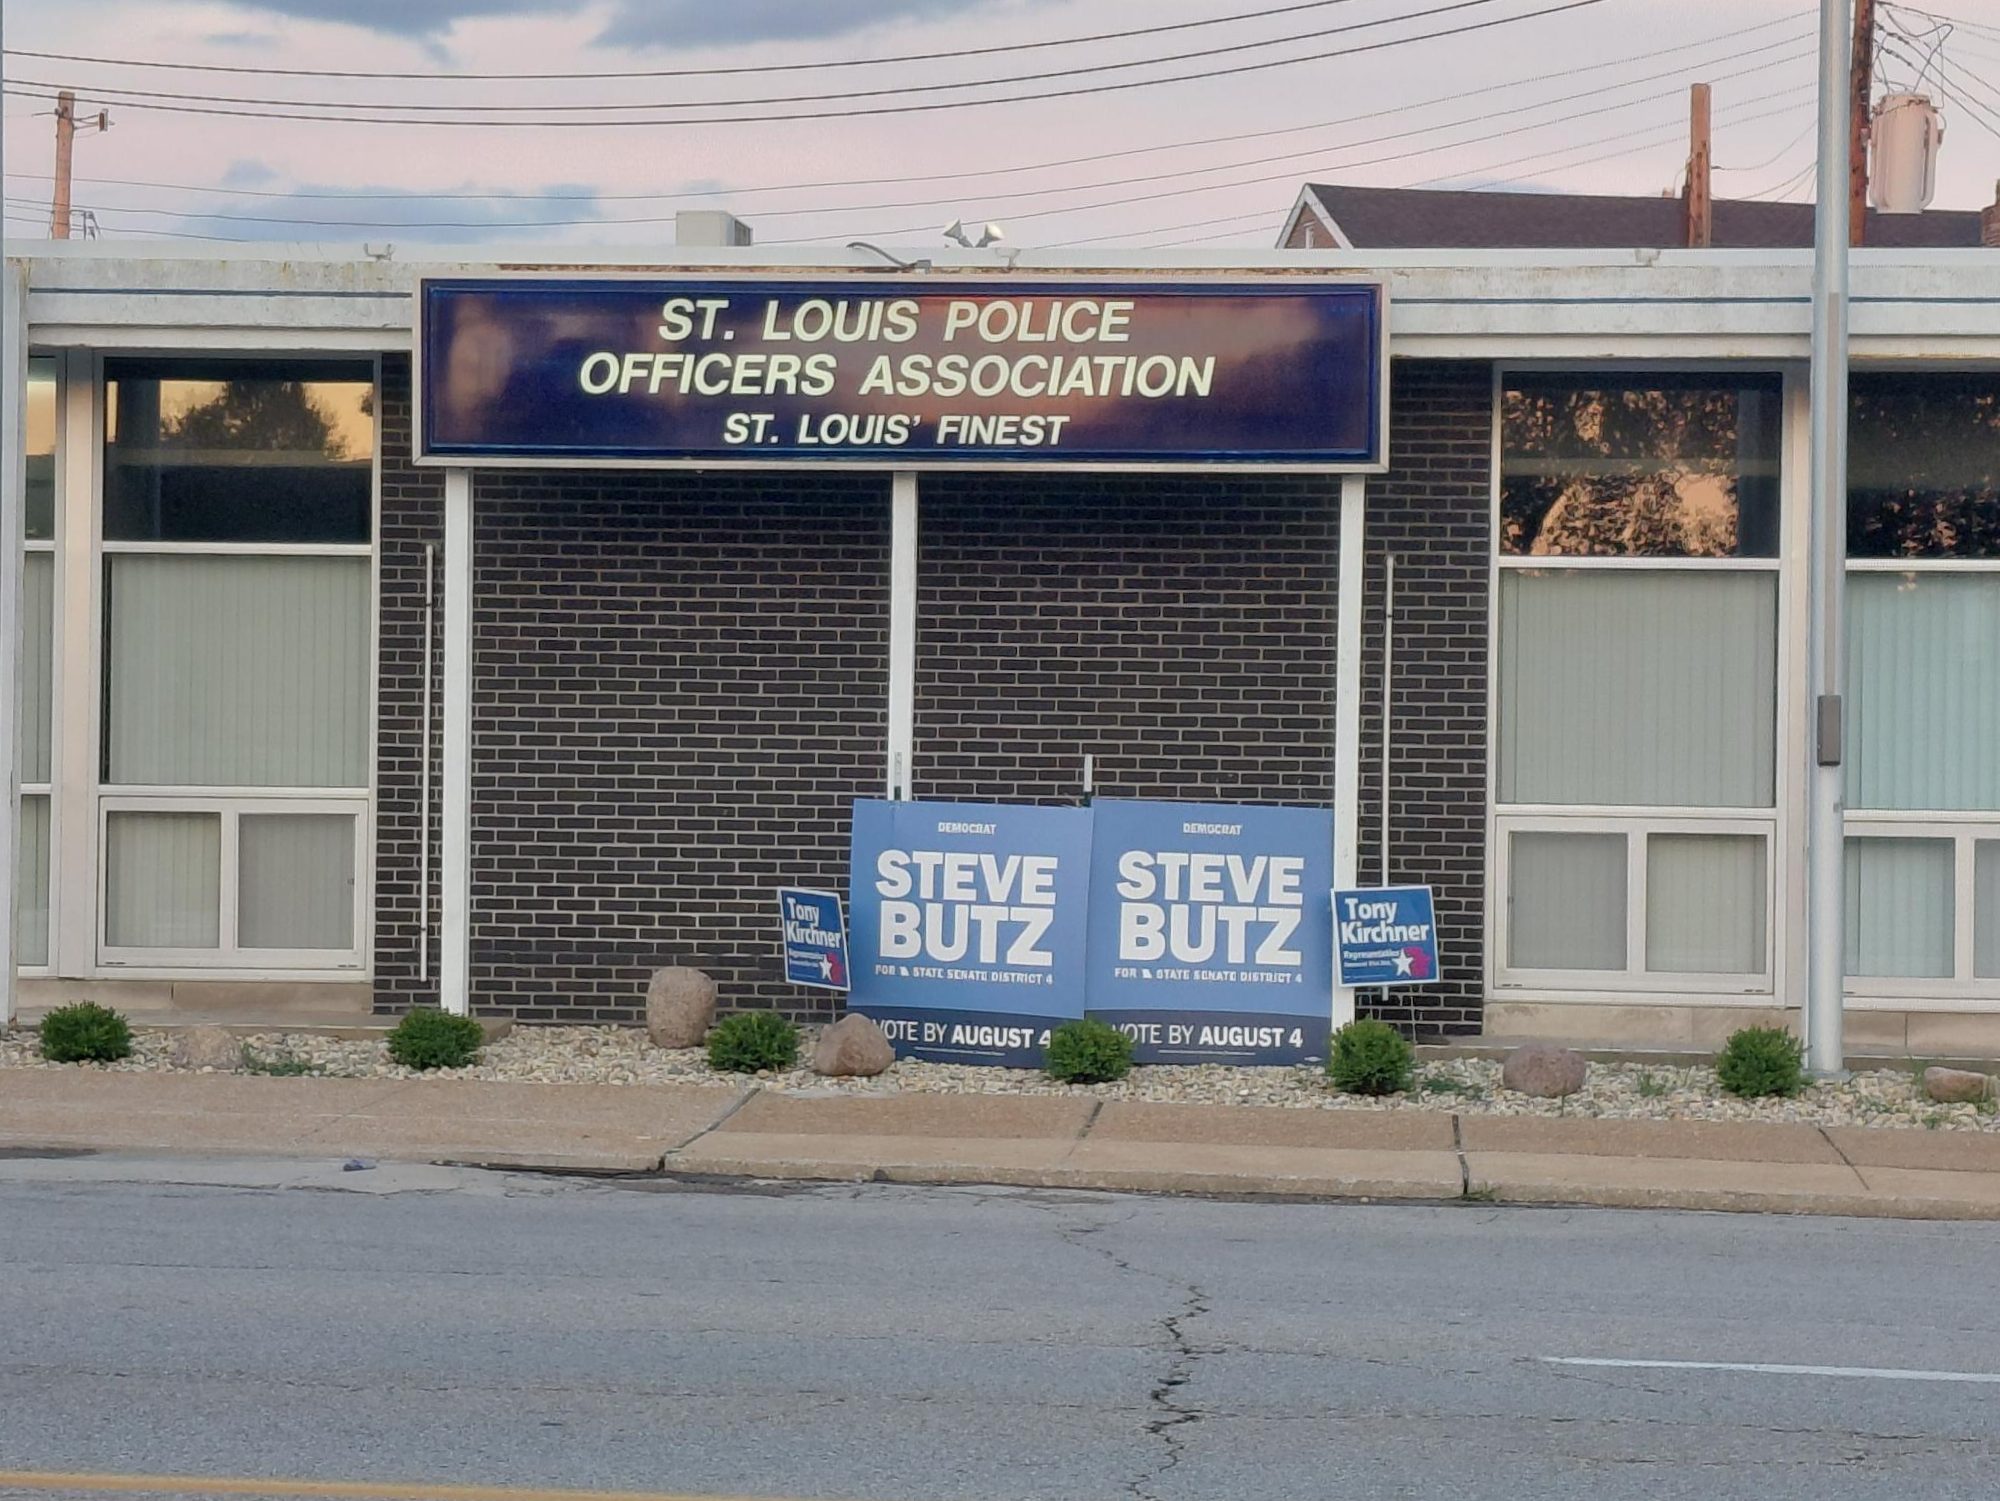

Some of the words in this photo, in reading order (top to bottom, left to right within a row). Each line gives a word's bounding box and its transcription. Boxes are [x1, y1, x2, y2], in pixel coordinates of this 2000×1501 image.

[658, 298, 735, 341] ST.
[762, 299, 919, 342] LOUIS
[943, 300, 1134, 342] POLICE
[580, 351, 837, 396] OFFICERS
[858, 354, 1215, 397] ASSOCIATION
[723, 413, 779, 444] ST.
[936, 415, 1070, 445] FINEST
[937, 821, 997, 835] DEMOCRAT
[1183, 822, 1242, 835] DEMOCRAT
[875, 849, 1059, 905] STEVE
[1116, 850, 1304, 905] STEVE
[786, 897, 820, 928] Tony
[1344, 897, 1398, 924] Tony
[786, 920, 841, 949] Kirchner
[879, 899, 1054, 967] BUTZ
[1119, 901, 1302, 966] BUTZ
[1341, 919, 1430, 944] Kirchner
[913, 967, 944, 979] STATE
[947, 968, 987, 982] SENATE
[991, 970, 1043, 985] DISTRICT
[1114, 967, 1137, 979] FOR
[1240, 971, 1291, 984] DISTRICT
[924, 1022, 948, 1044] BY
[951, 1024, 1034, 1049] AUGUST
[1038, 1029, 1052, 1049] 4
[1168, 1023, 1194, 1045] BY
[1199, 1026, 1285, 1048] AUGUST
[1288, 1028, 1303, 1048] 4
